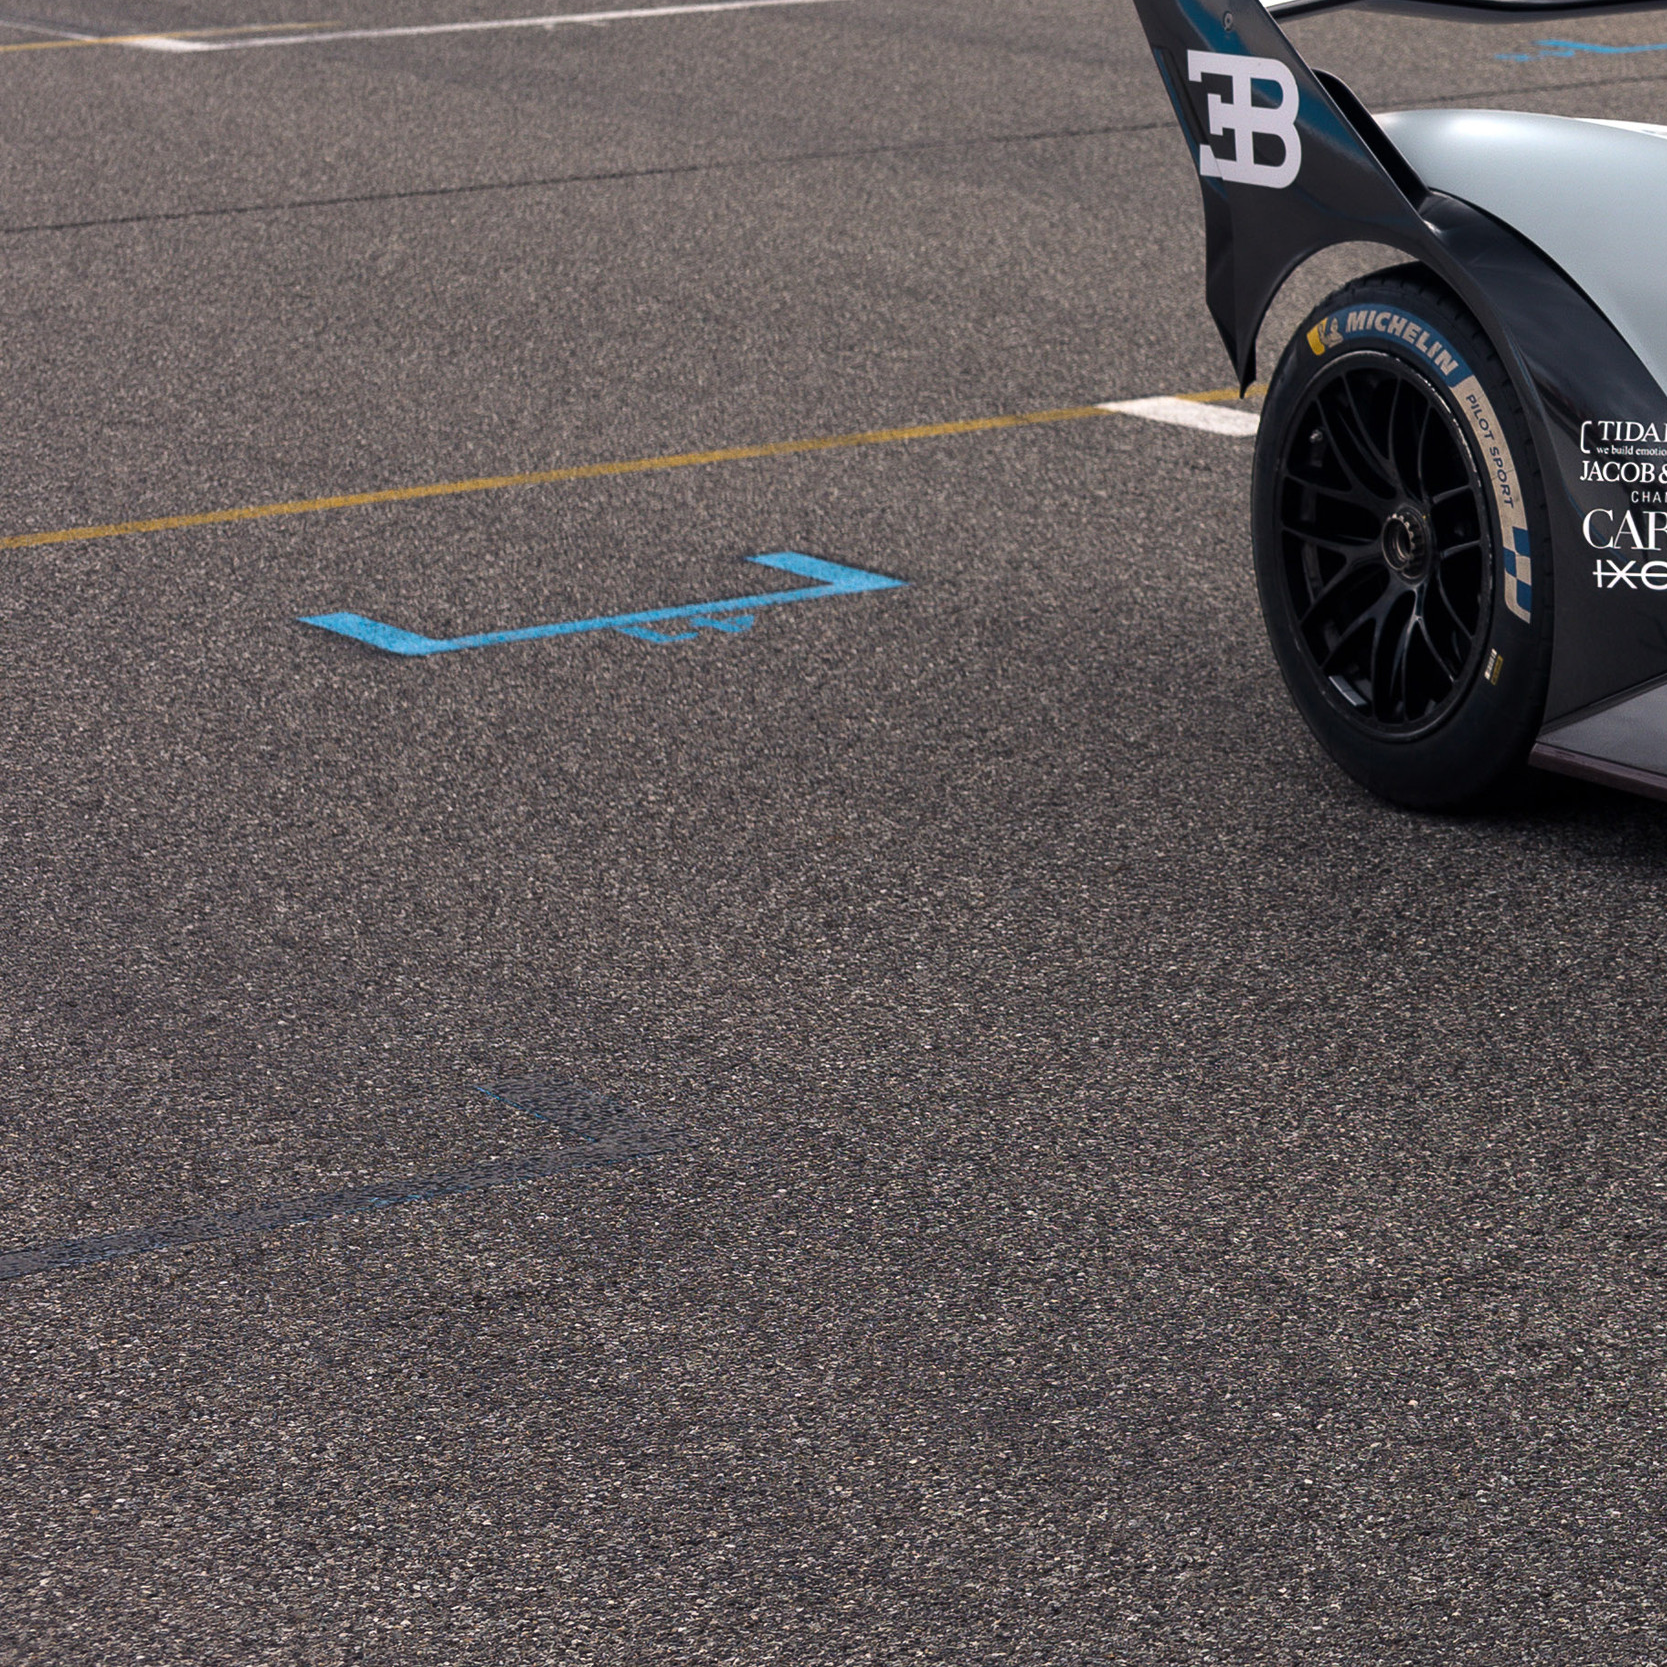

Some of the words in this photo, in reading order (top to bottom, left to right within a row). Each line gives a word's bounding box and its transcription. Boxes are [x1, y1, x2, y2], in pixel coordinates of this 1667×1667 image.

[1345, 310, 1459, 376] MICHELIN
[1465, 394, 1495, 440] PILOT
[1489, 446, 1514, 508] SPORT
[1596, 447, 1610, 455] we
[1611, 445, 1634, 455] build
